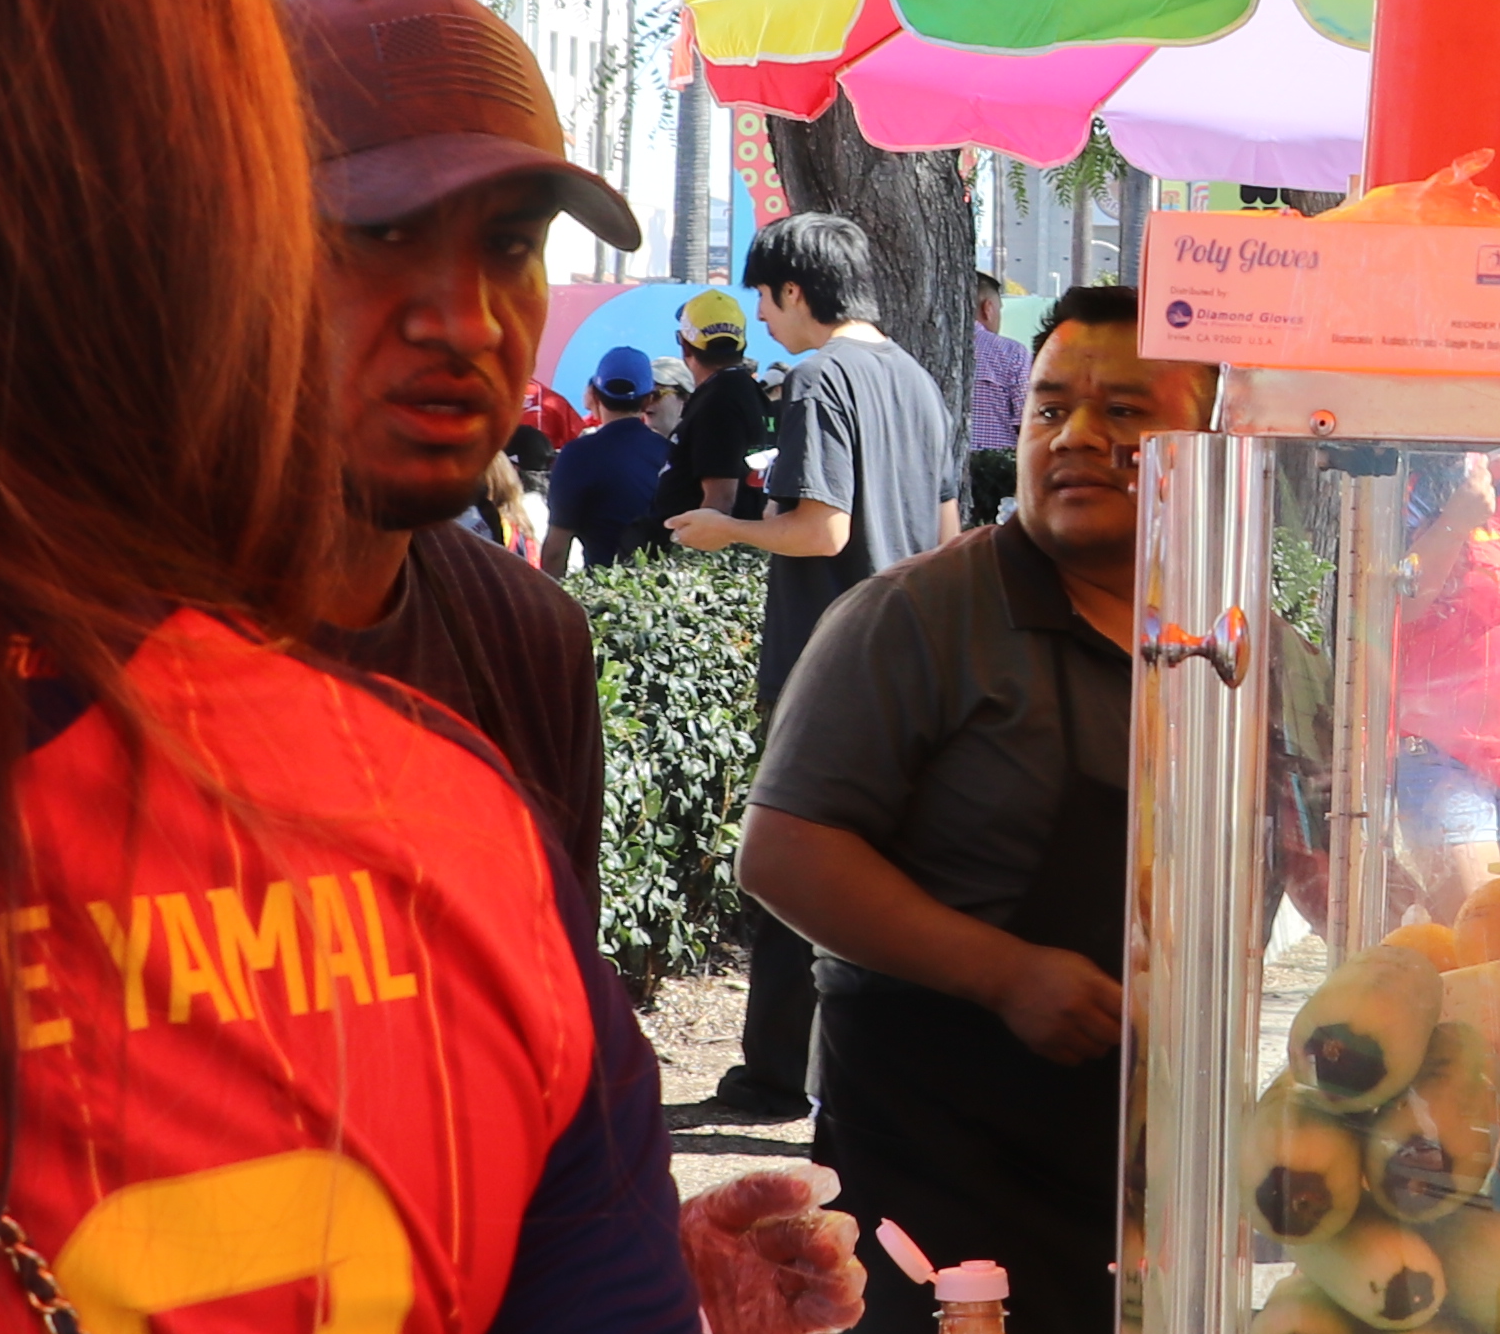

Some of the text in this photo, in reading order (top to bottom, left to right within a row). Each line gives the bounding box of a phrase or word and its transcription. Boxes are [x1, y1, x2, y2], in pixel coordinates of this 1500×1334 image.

[1174, 234, 1320, 273] Poly Gloves
[1197, 308, 1304, 325] Diamond Gloves
[1196, 333, 1210, 343] CA
[86, 870, 419, 1032] YAMAL
